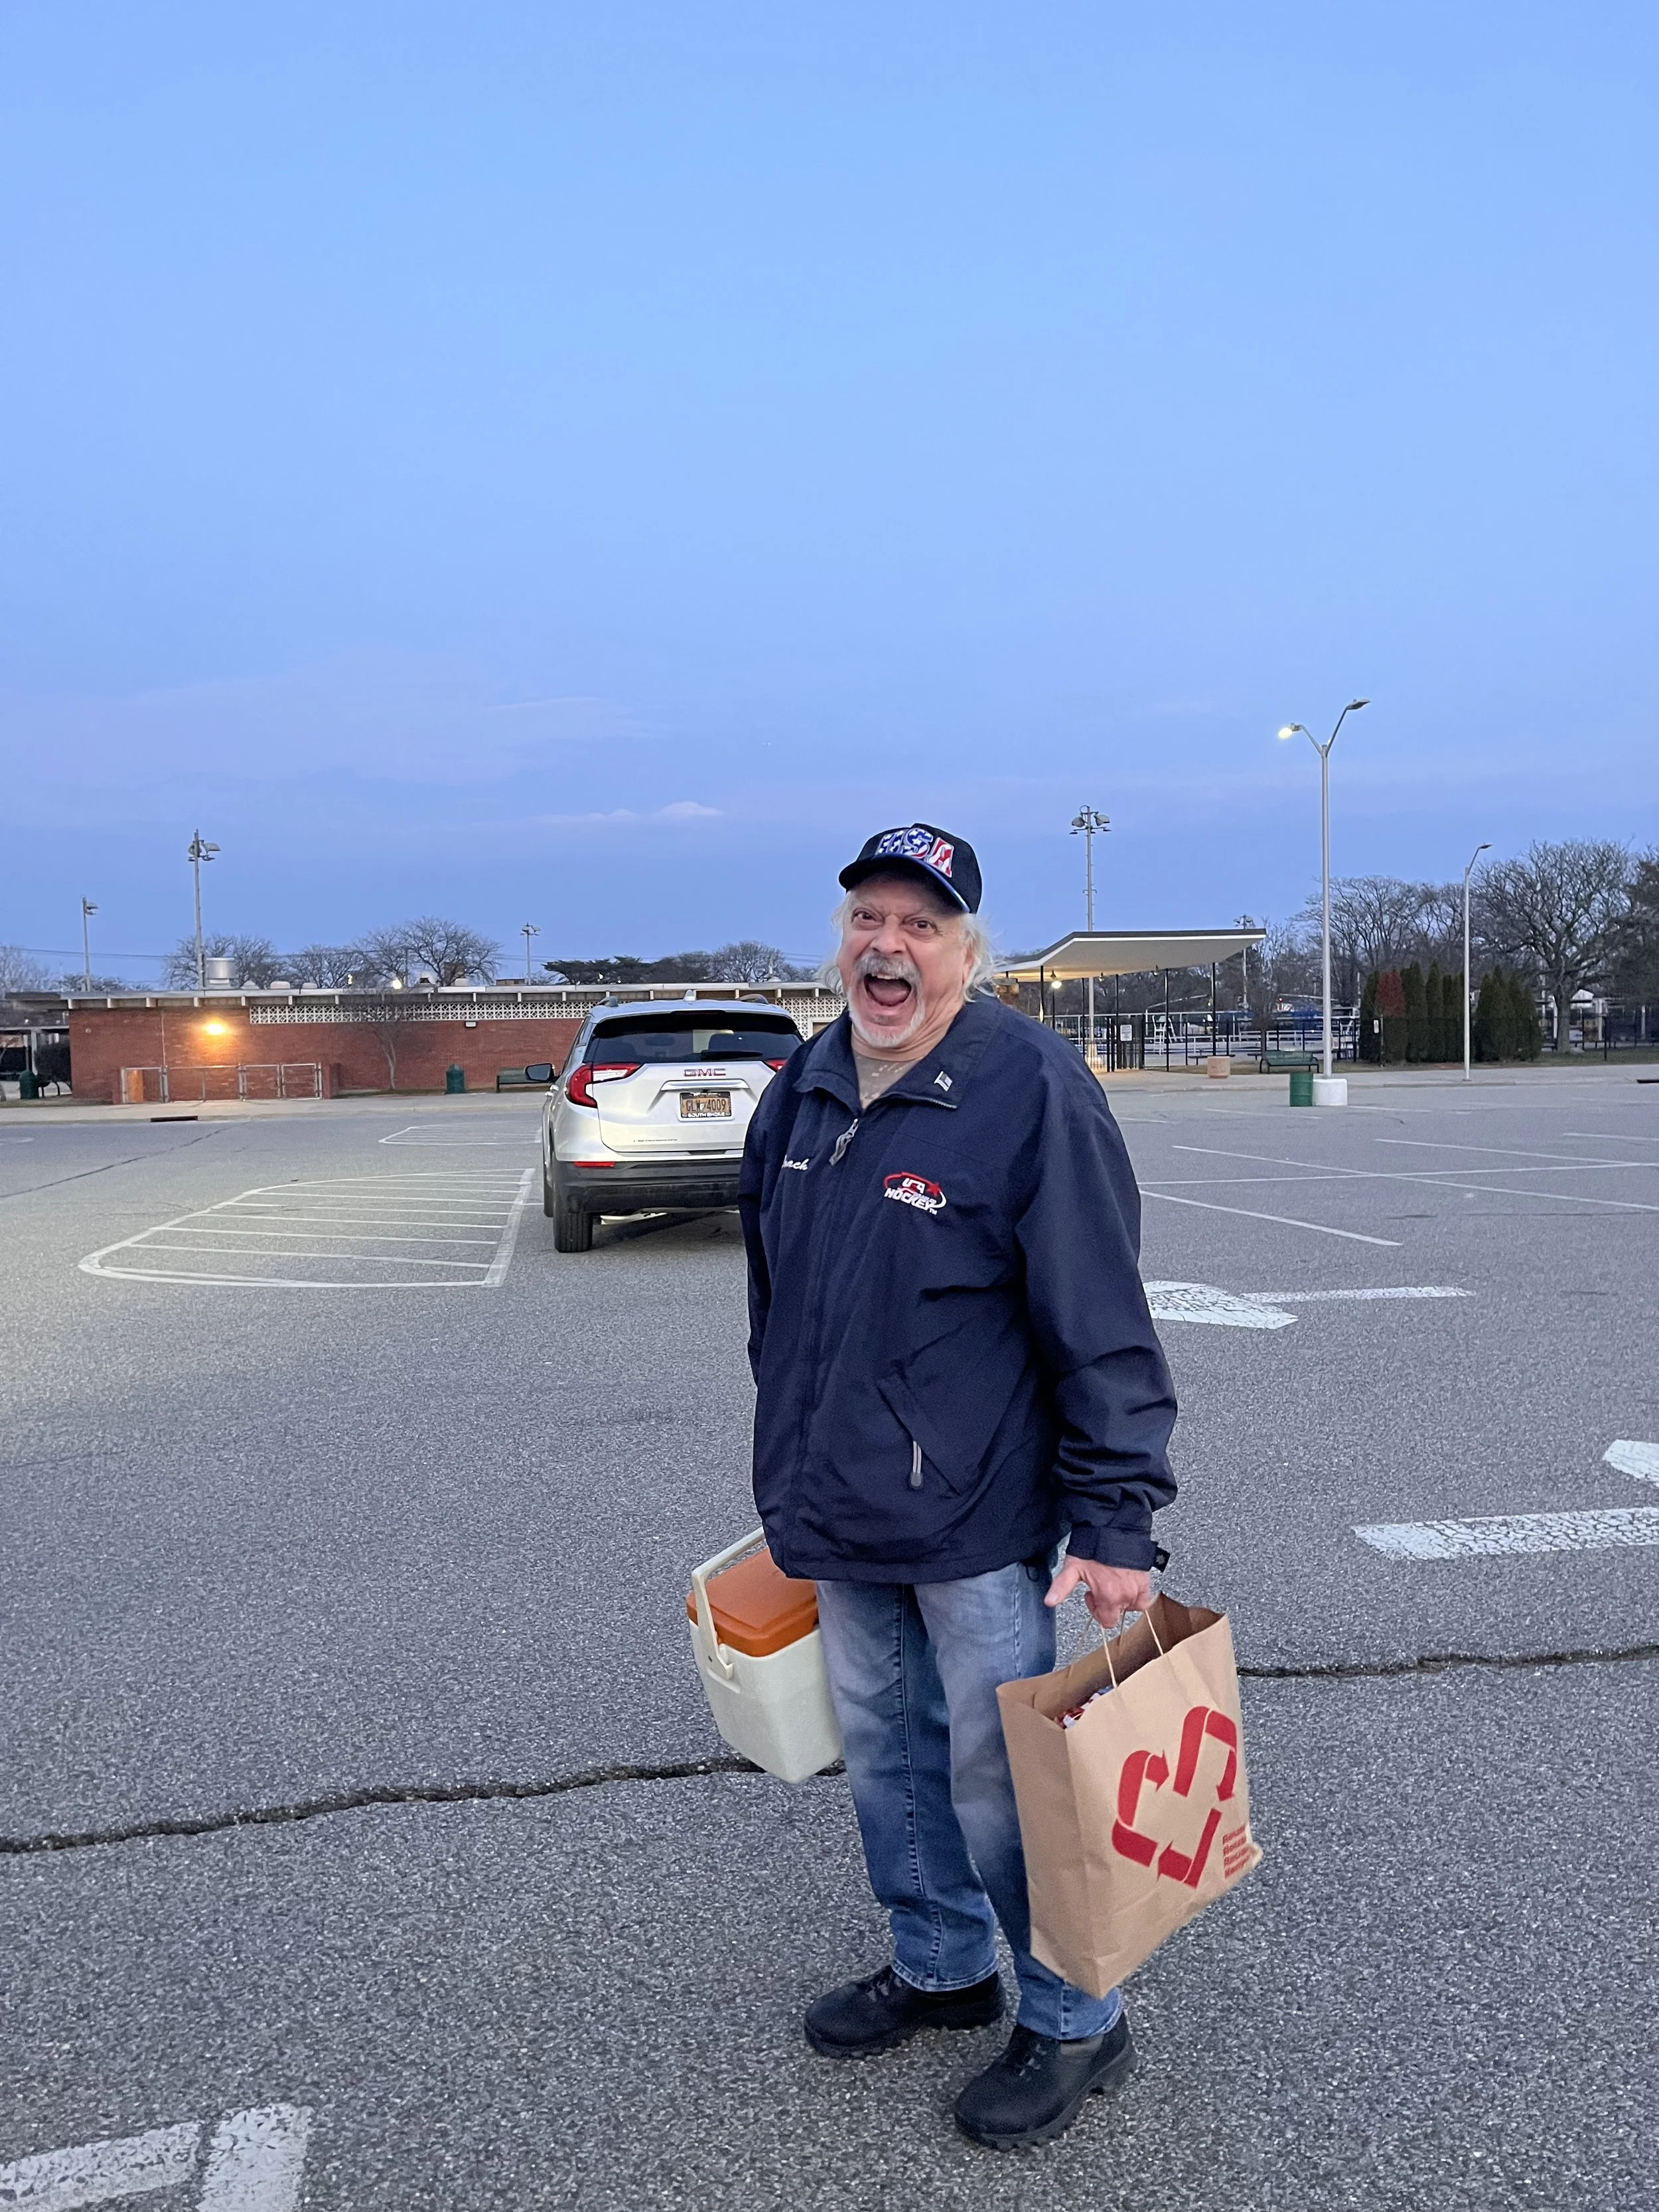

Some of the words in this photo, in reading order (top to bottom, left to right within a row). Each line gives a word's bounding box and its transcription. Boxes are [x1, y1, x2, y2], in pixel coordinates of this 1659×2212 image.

[874, 828, 954, 878] USA
[684, 1068, 726, 1076] GMC
[707, 1098, 726, 1111] 4009
[884, 1187, 936, 1211] HOCKEY
